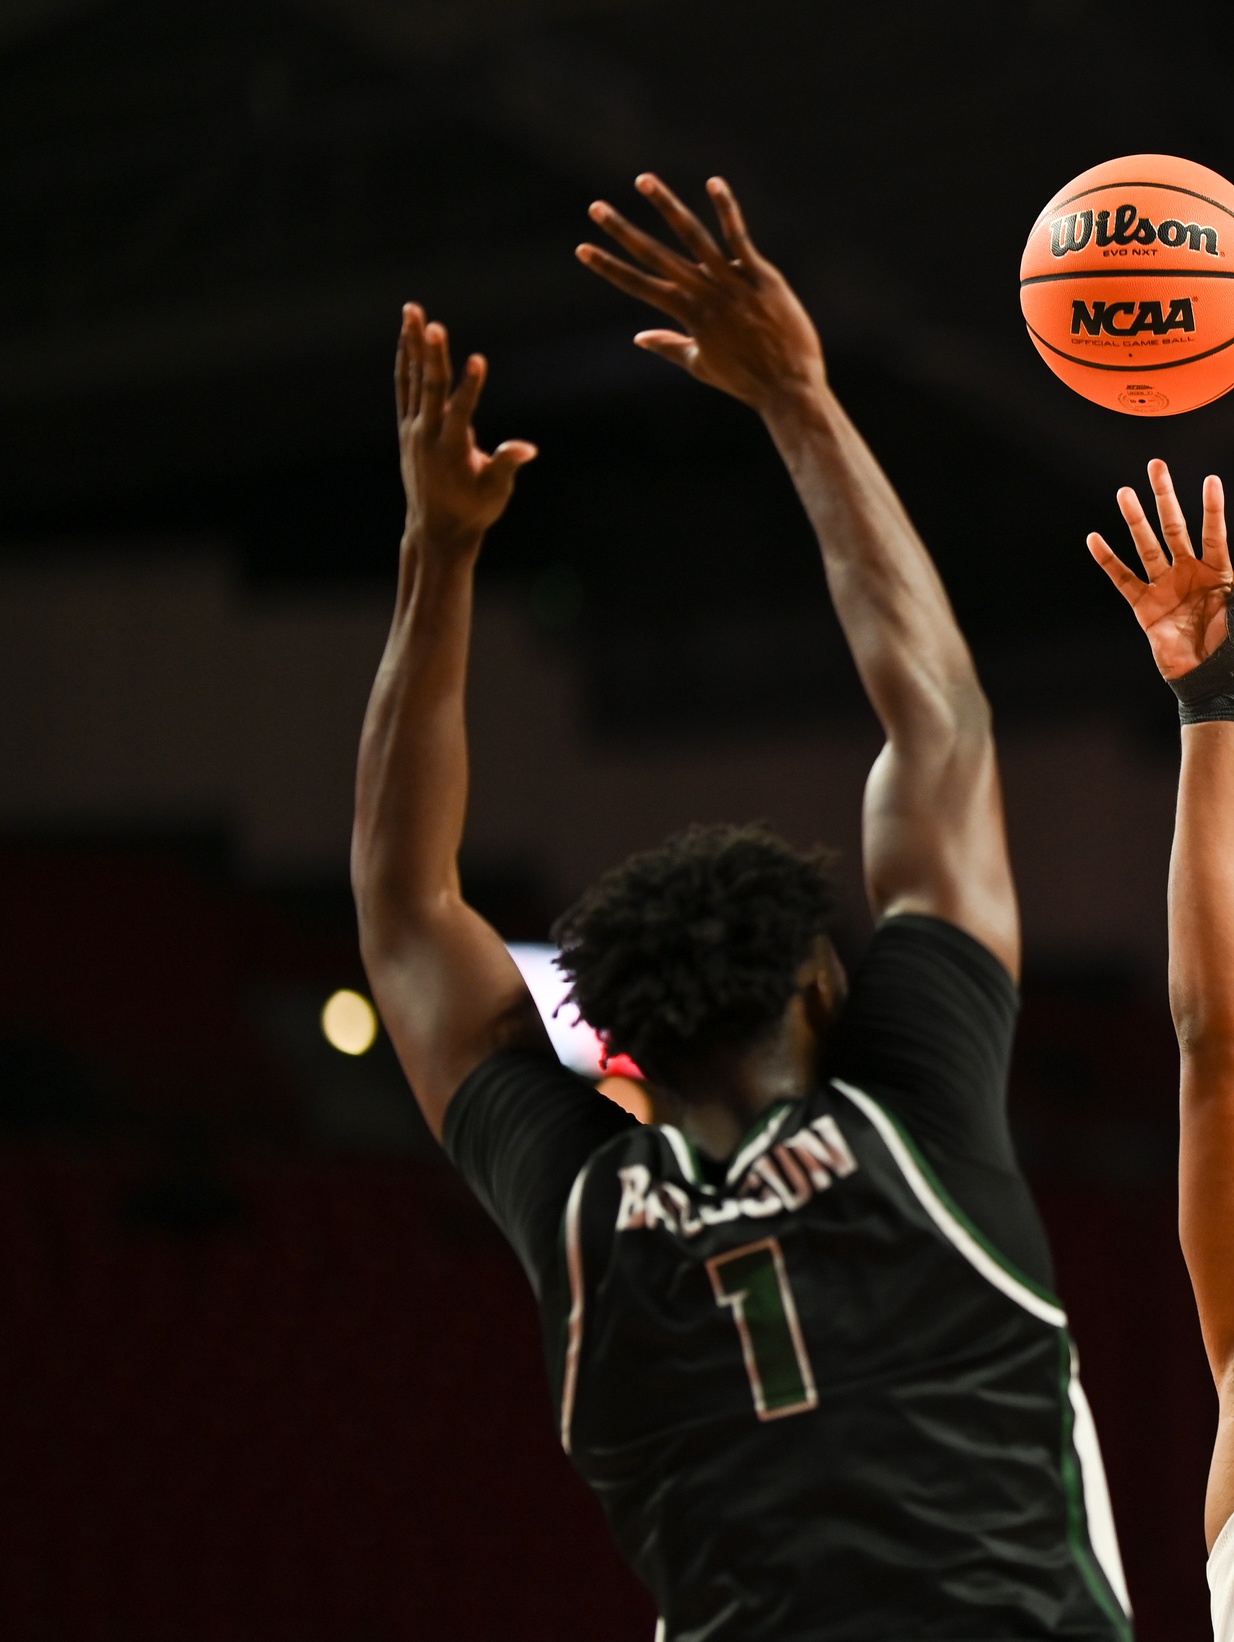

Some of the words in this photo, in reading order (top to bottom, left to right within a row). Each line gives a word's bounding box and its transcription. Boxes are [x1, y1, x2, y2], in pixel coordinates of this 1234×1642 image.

[1050, 203, 1219, 258] Wilson
[1103, 249, 1127, 257] EVO
[1070, 297, 1196, 337] NCAA
[1071, 338, 1119, 347] OFFICIAL
[1123, 339, 1158, 347] GAME
[1162, 336, 1195, 345] BALL
[705, 1237, 818, 1421] 1
